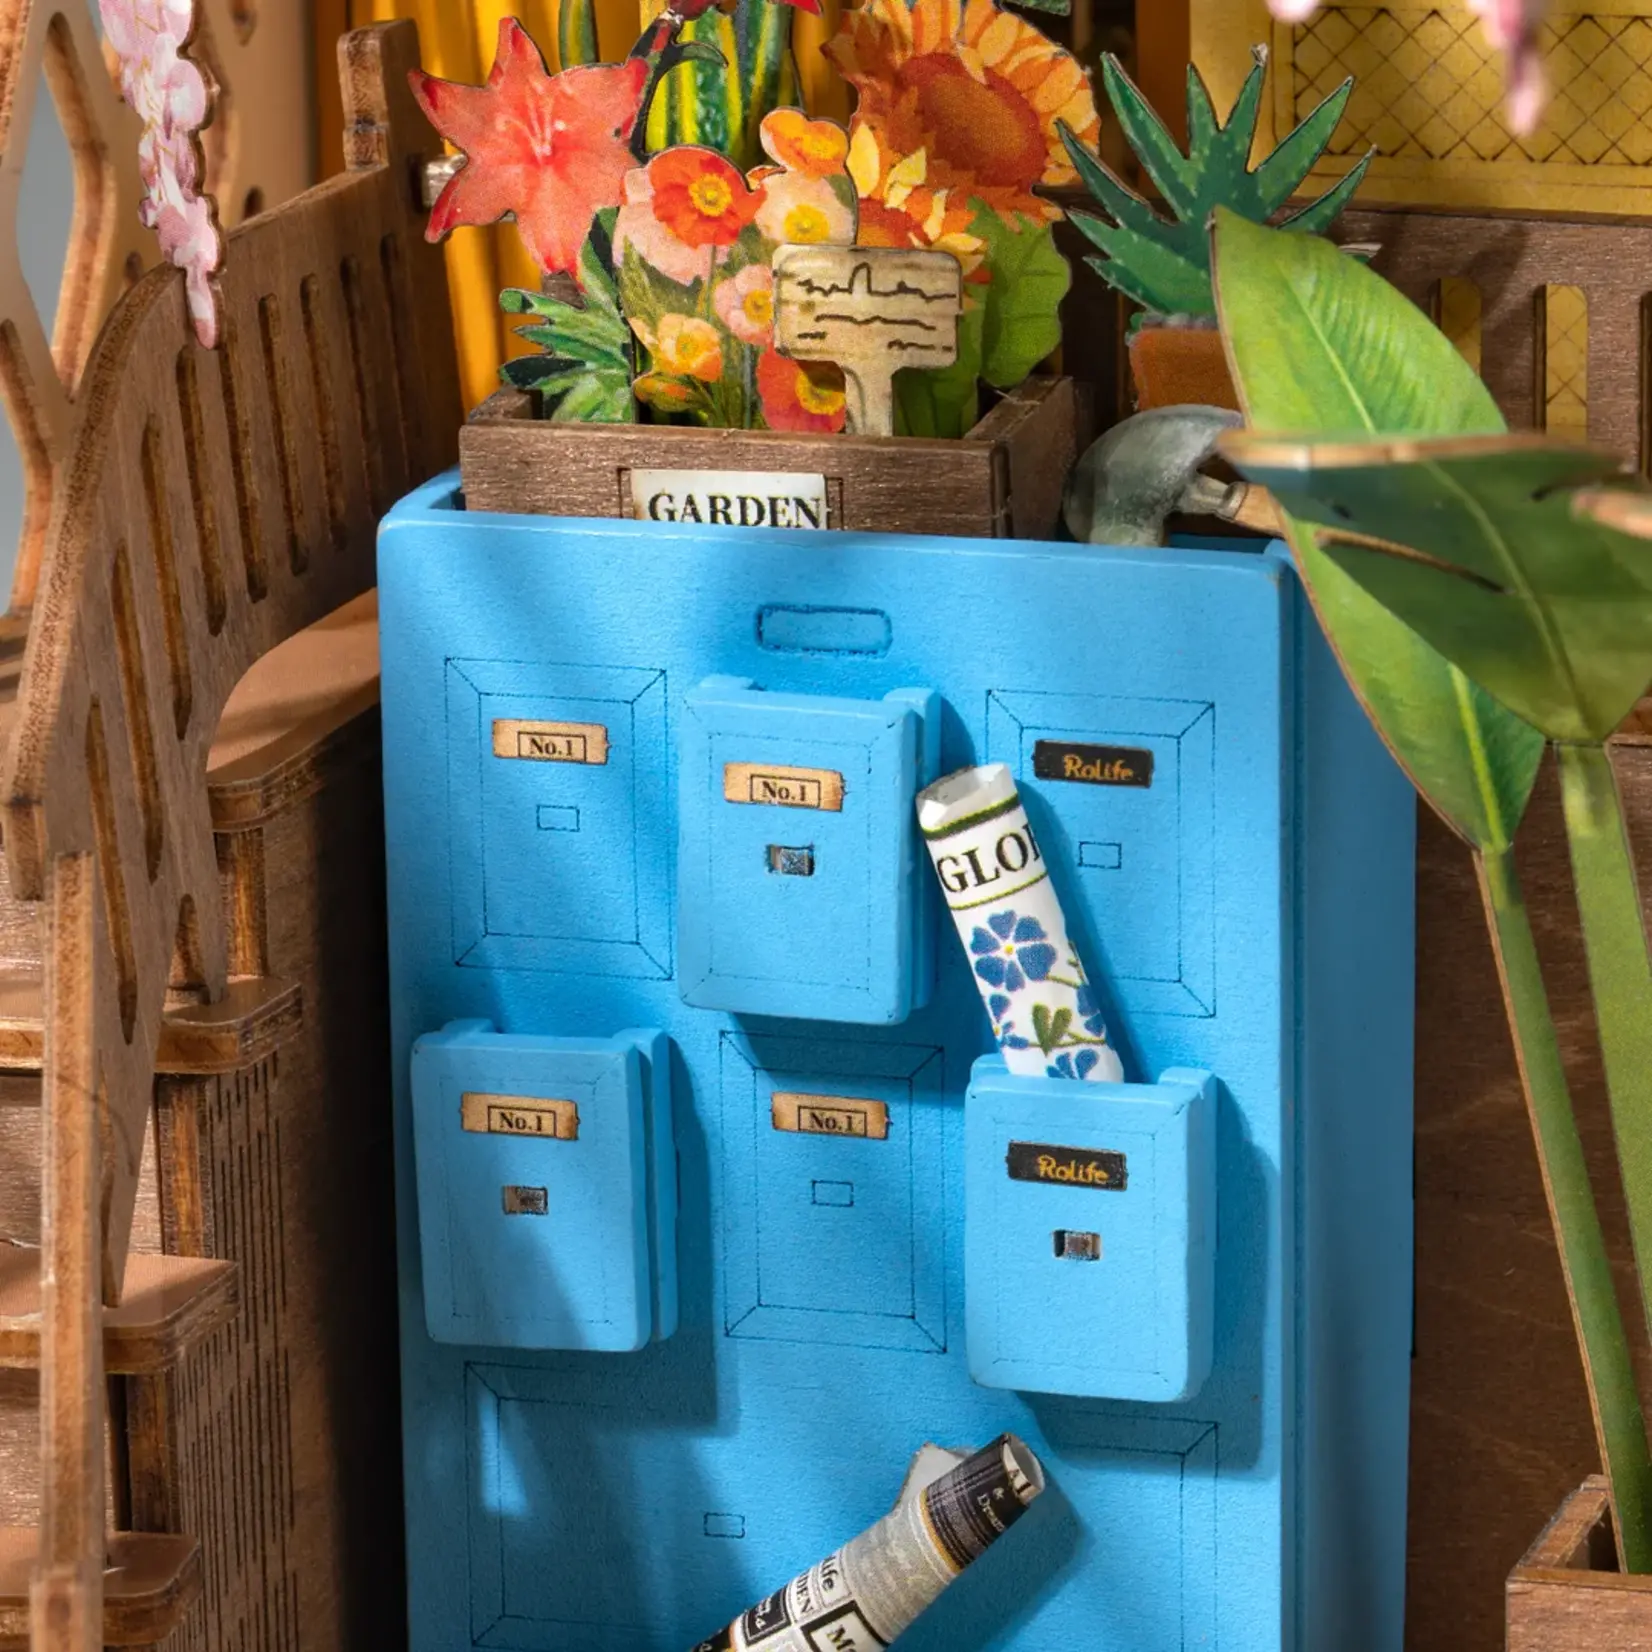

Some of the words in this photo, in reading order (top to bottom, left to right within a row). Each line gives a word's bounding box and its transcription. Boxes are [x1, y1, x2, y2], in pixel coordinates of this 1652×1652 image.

[648, 488, 821, 530] GARDEN
[528, 736, 575, 758] No.1
[1063, 753, 1136, 782] Rolife
[761, 780, 808, 803] No.1
[499, 1111, 544, 1133] No.1
[809, 1110, 854, 1133] No.1
[1036, 1153, 1110, 1185] Rolife
